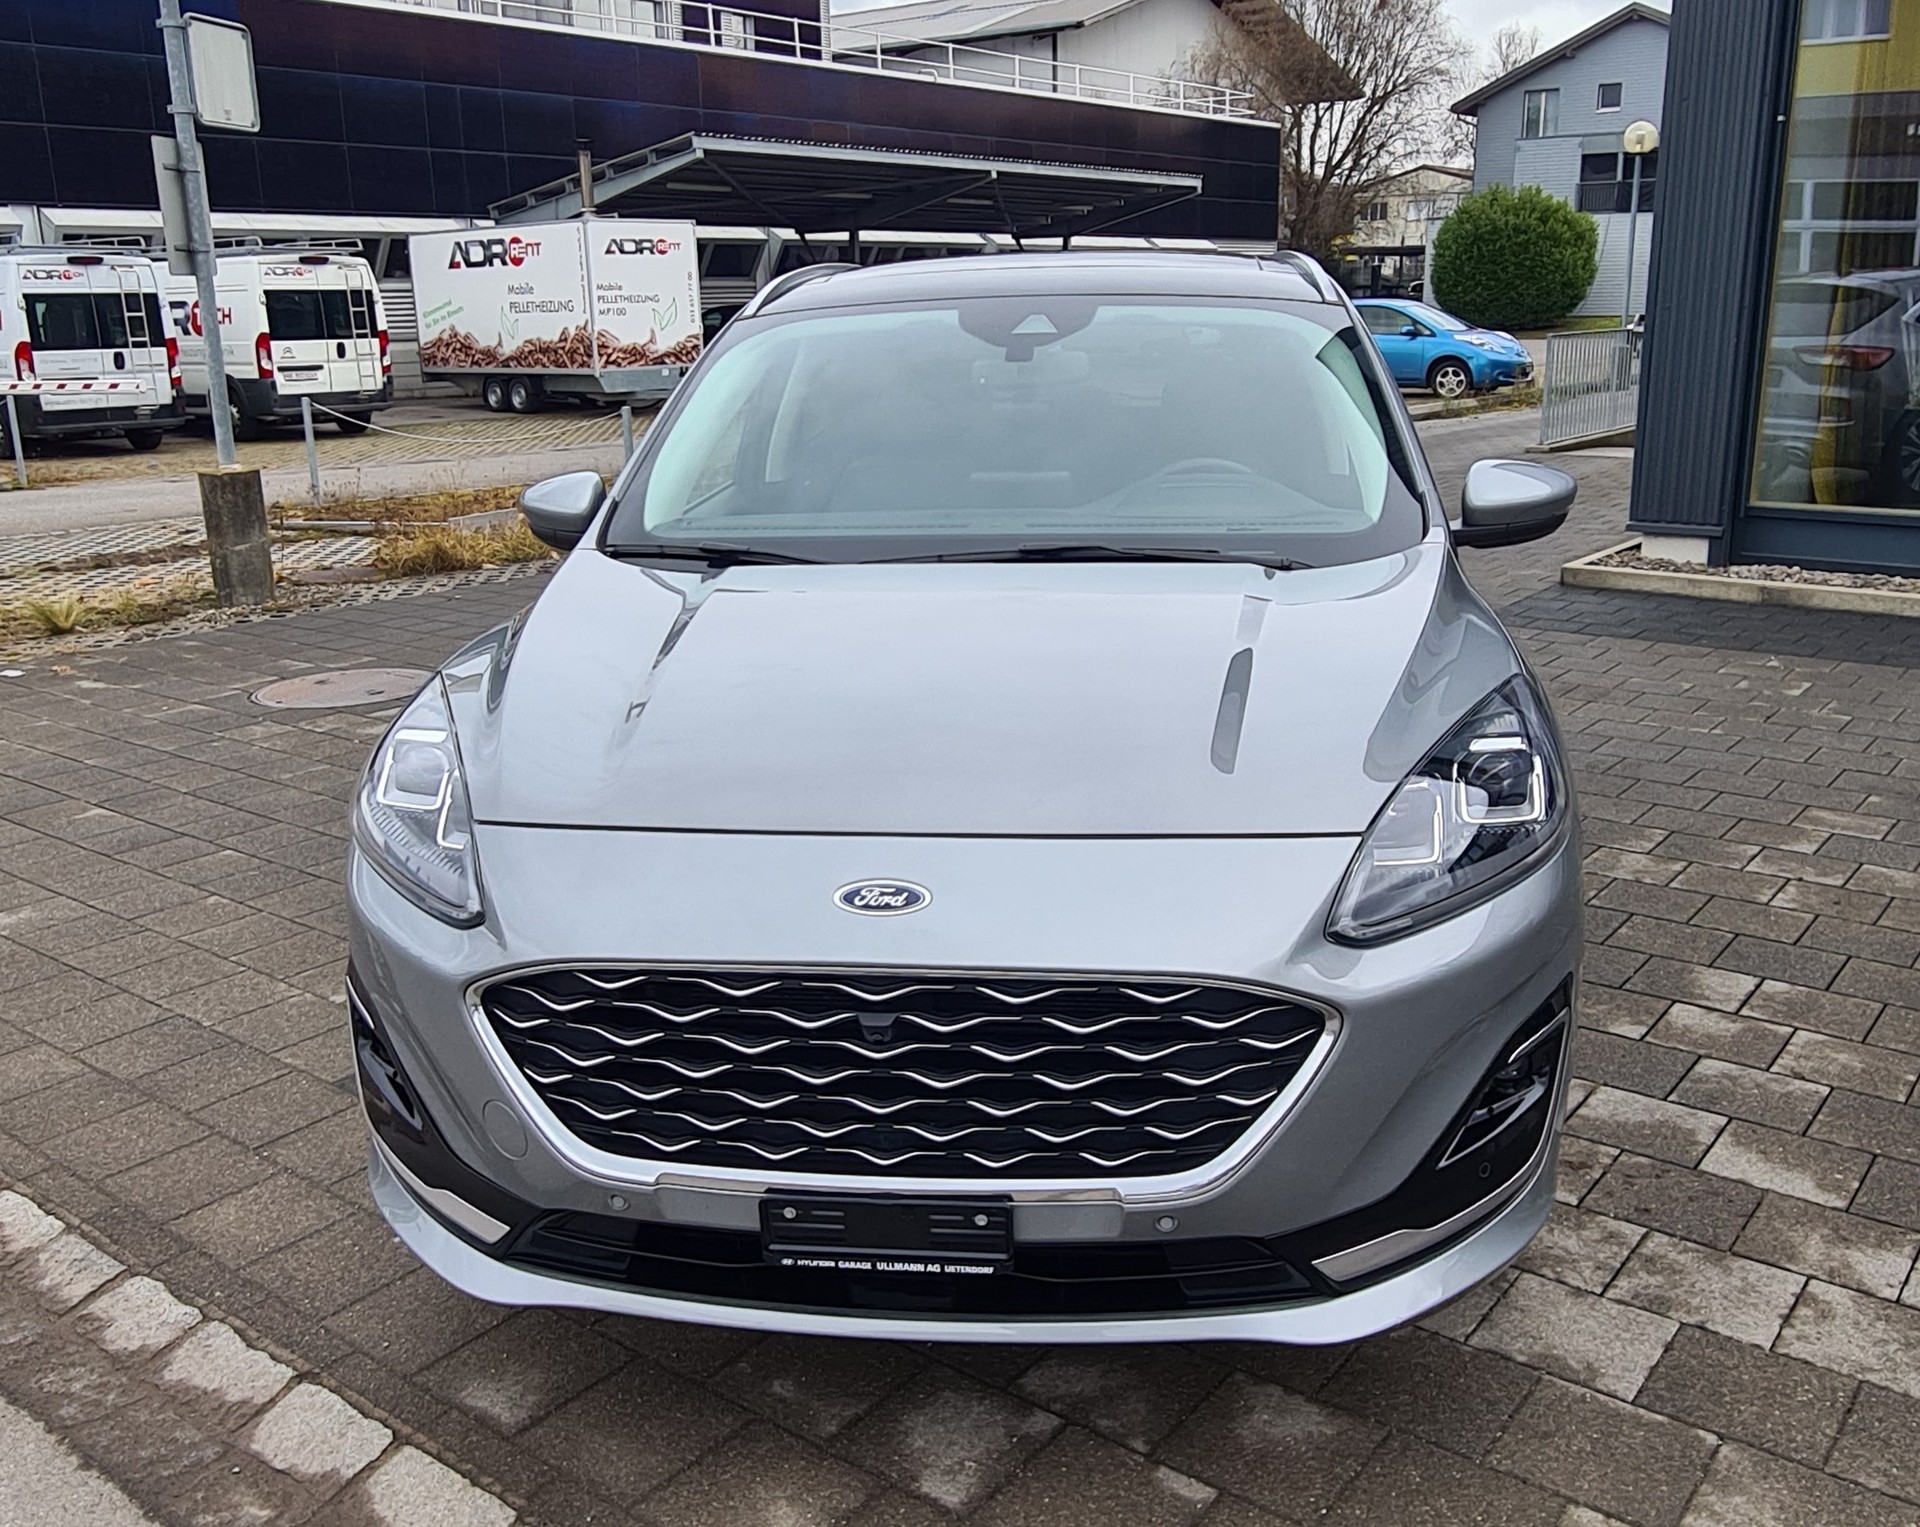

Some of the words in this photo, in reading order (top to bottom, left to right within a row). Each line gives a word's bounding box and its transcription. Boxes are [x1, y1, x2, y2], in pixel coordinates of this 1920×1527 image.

[507, 282, 534, 295] Mobile
[596, 282, 623, 291] Mobile
[597, 294, 660, 304] PELLETHEIZUNG
[509, 299, 574, 313] PELLETHEIZUNG
[853, 886, 909, 907] Ford
[838, 1260, 873, 1270] GARAGE
[876, 1261, 925, 1272] ULLMANN
[926, 1263, 941, 1273] AG
